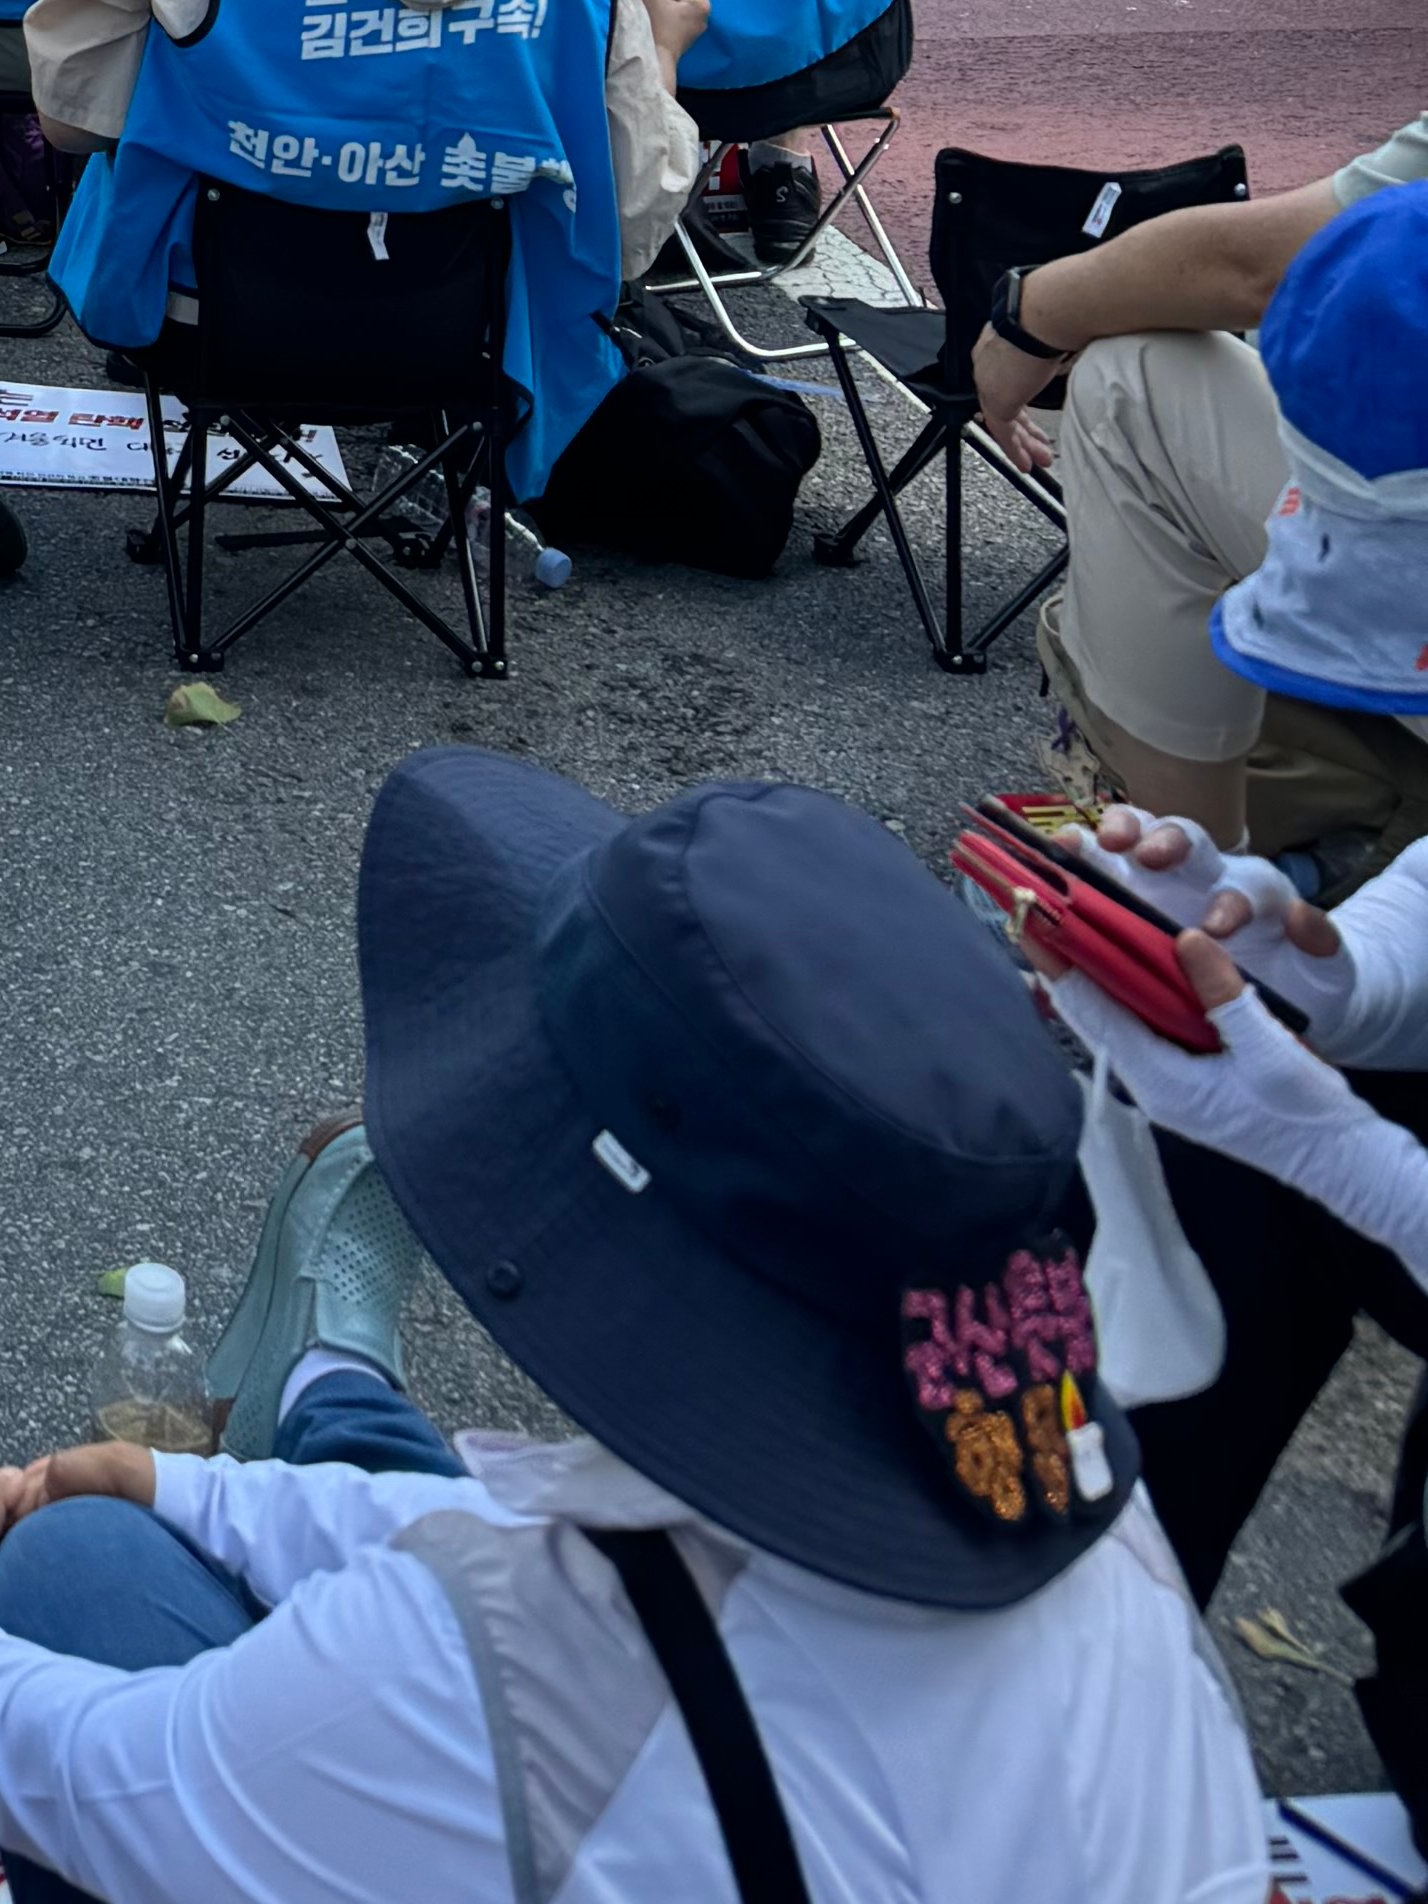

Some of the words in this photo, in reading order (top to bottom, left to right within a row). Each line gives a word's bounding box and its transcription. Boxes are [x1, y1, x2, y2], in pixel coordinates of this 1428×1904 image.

[301, 7, 442, 60] 김건희
[228, 120, 426, 187] 천안·아산
[68, 411, 144, 431] 탄핵
